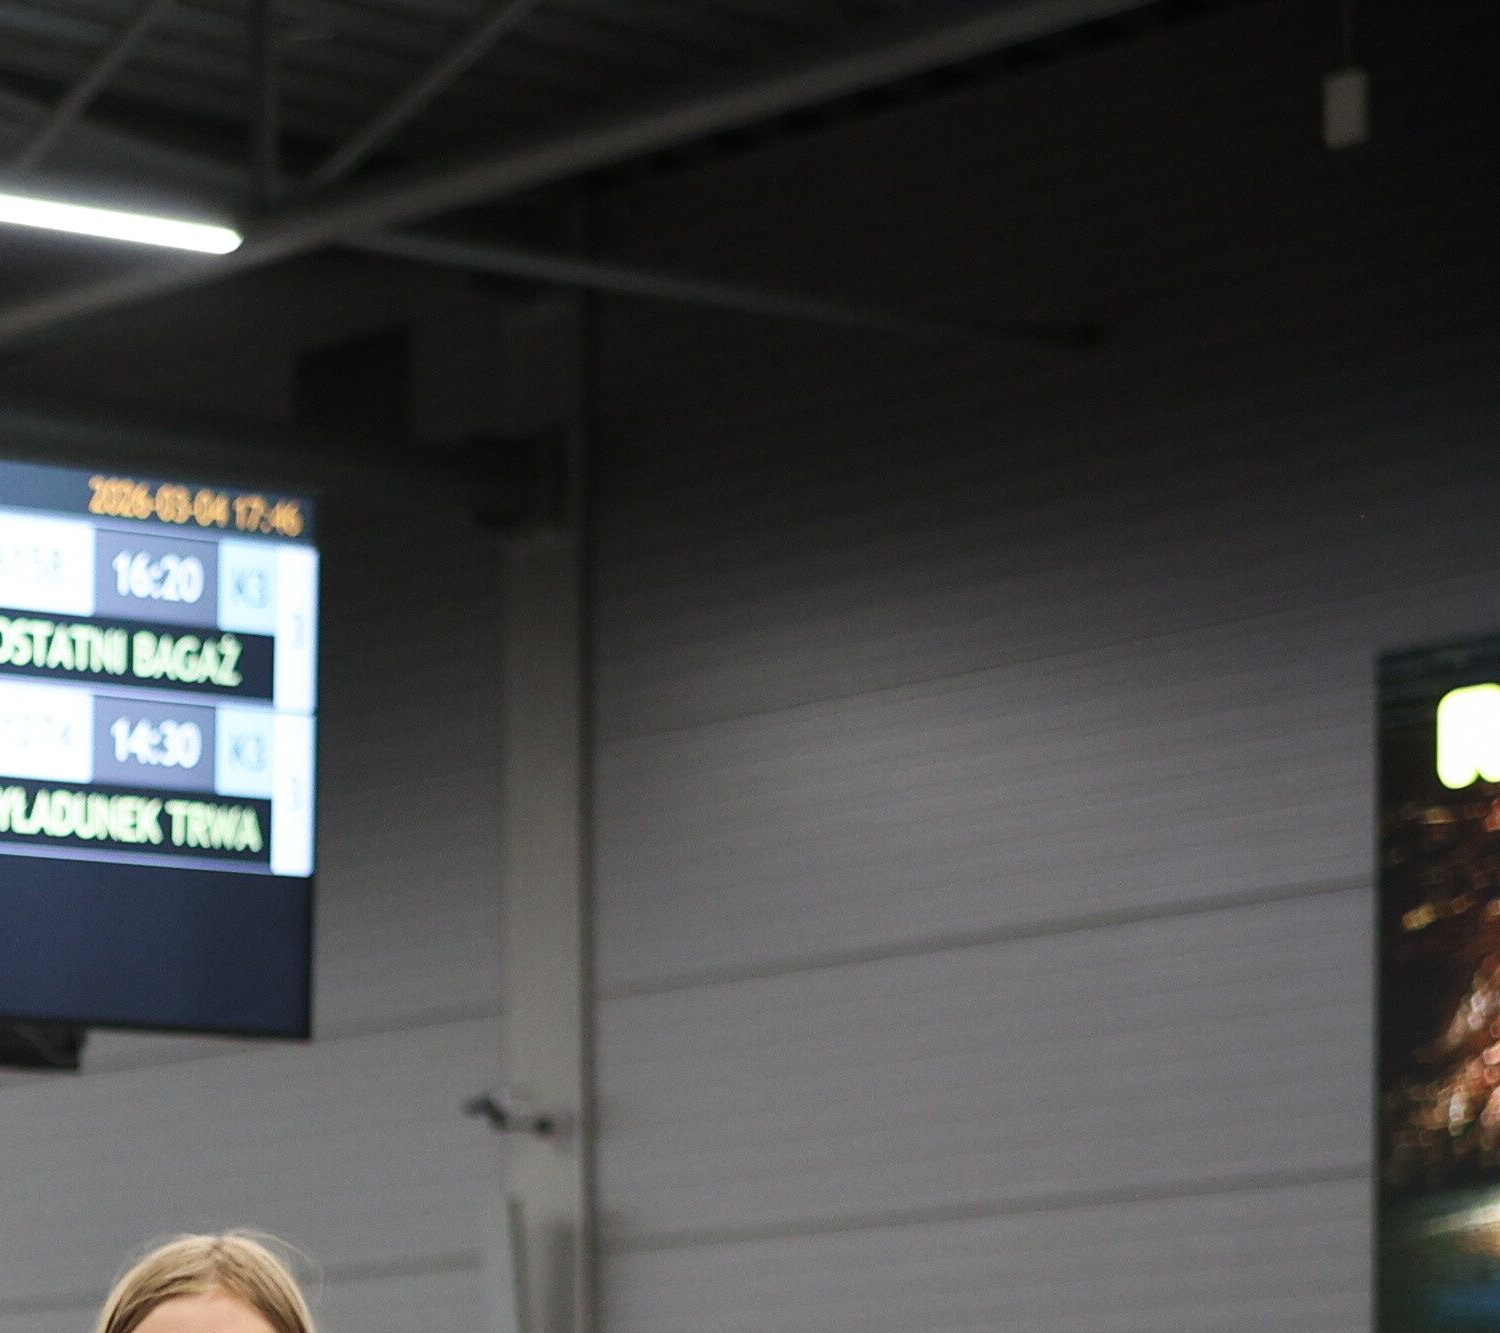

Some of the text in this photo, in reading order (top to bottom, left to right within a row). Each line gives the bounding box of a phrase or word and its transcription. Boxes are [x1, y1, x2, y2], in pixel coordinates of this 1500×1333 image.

[88, 475, 229, 527] 2026-03-04
[112, 551, 204, 603] 16:20
[132, 633, 243, 687] BAGAŻ
[111, 716, 201, 769] 14:30
[166, 799, 264, 853] TRWA
